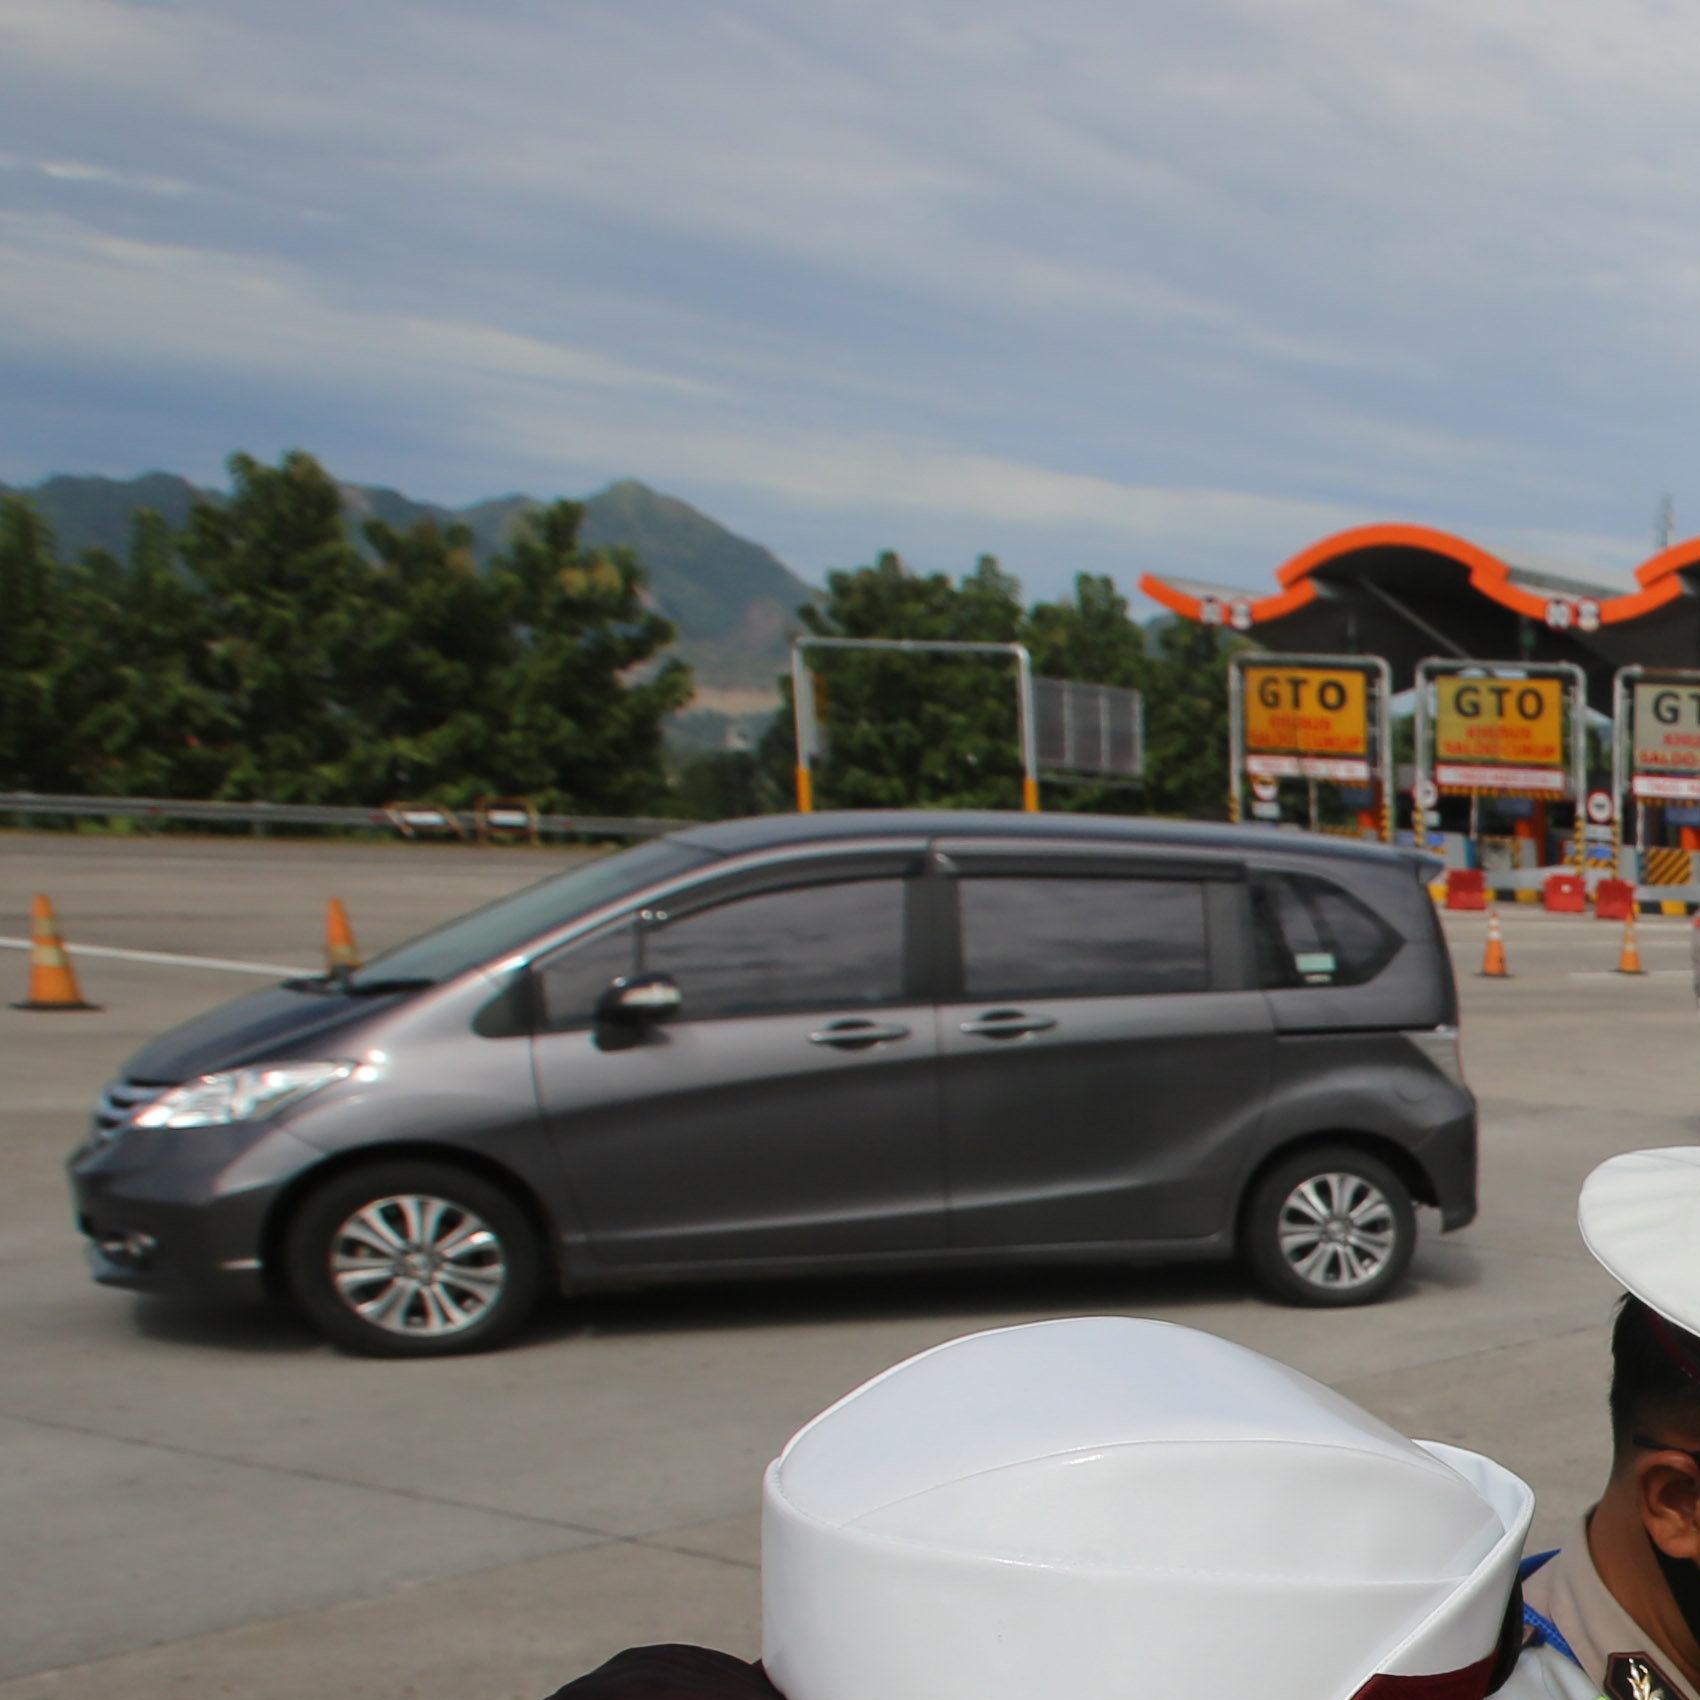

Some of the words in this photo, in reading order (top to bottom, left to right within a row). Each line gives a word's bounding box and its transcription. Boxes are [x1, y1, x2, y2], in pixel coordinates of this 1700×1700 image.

[1258, 676, 1347, 711] GTO
[1453, 686, 1545, 720] GTO
[1639, 748, 1697, 768] SALDO
